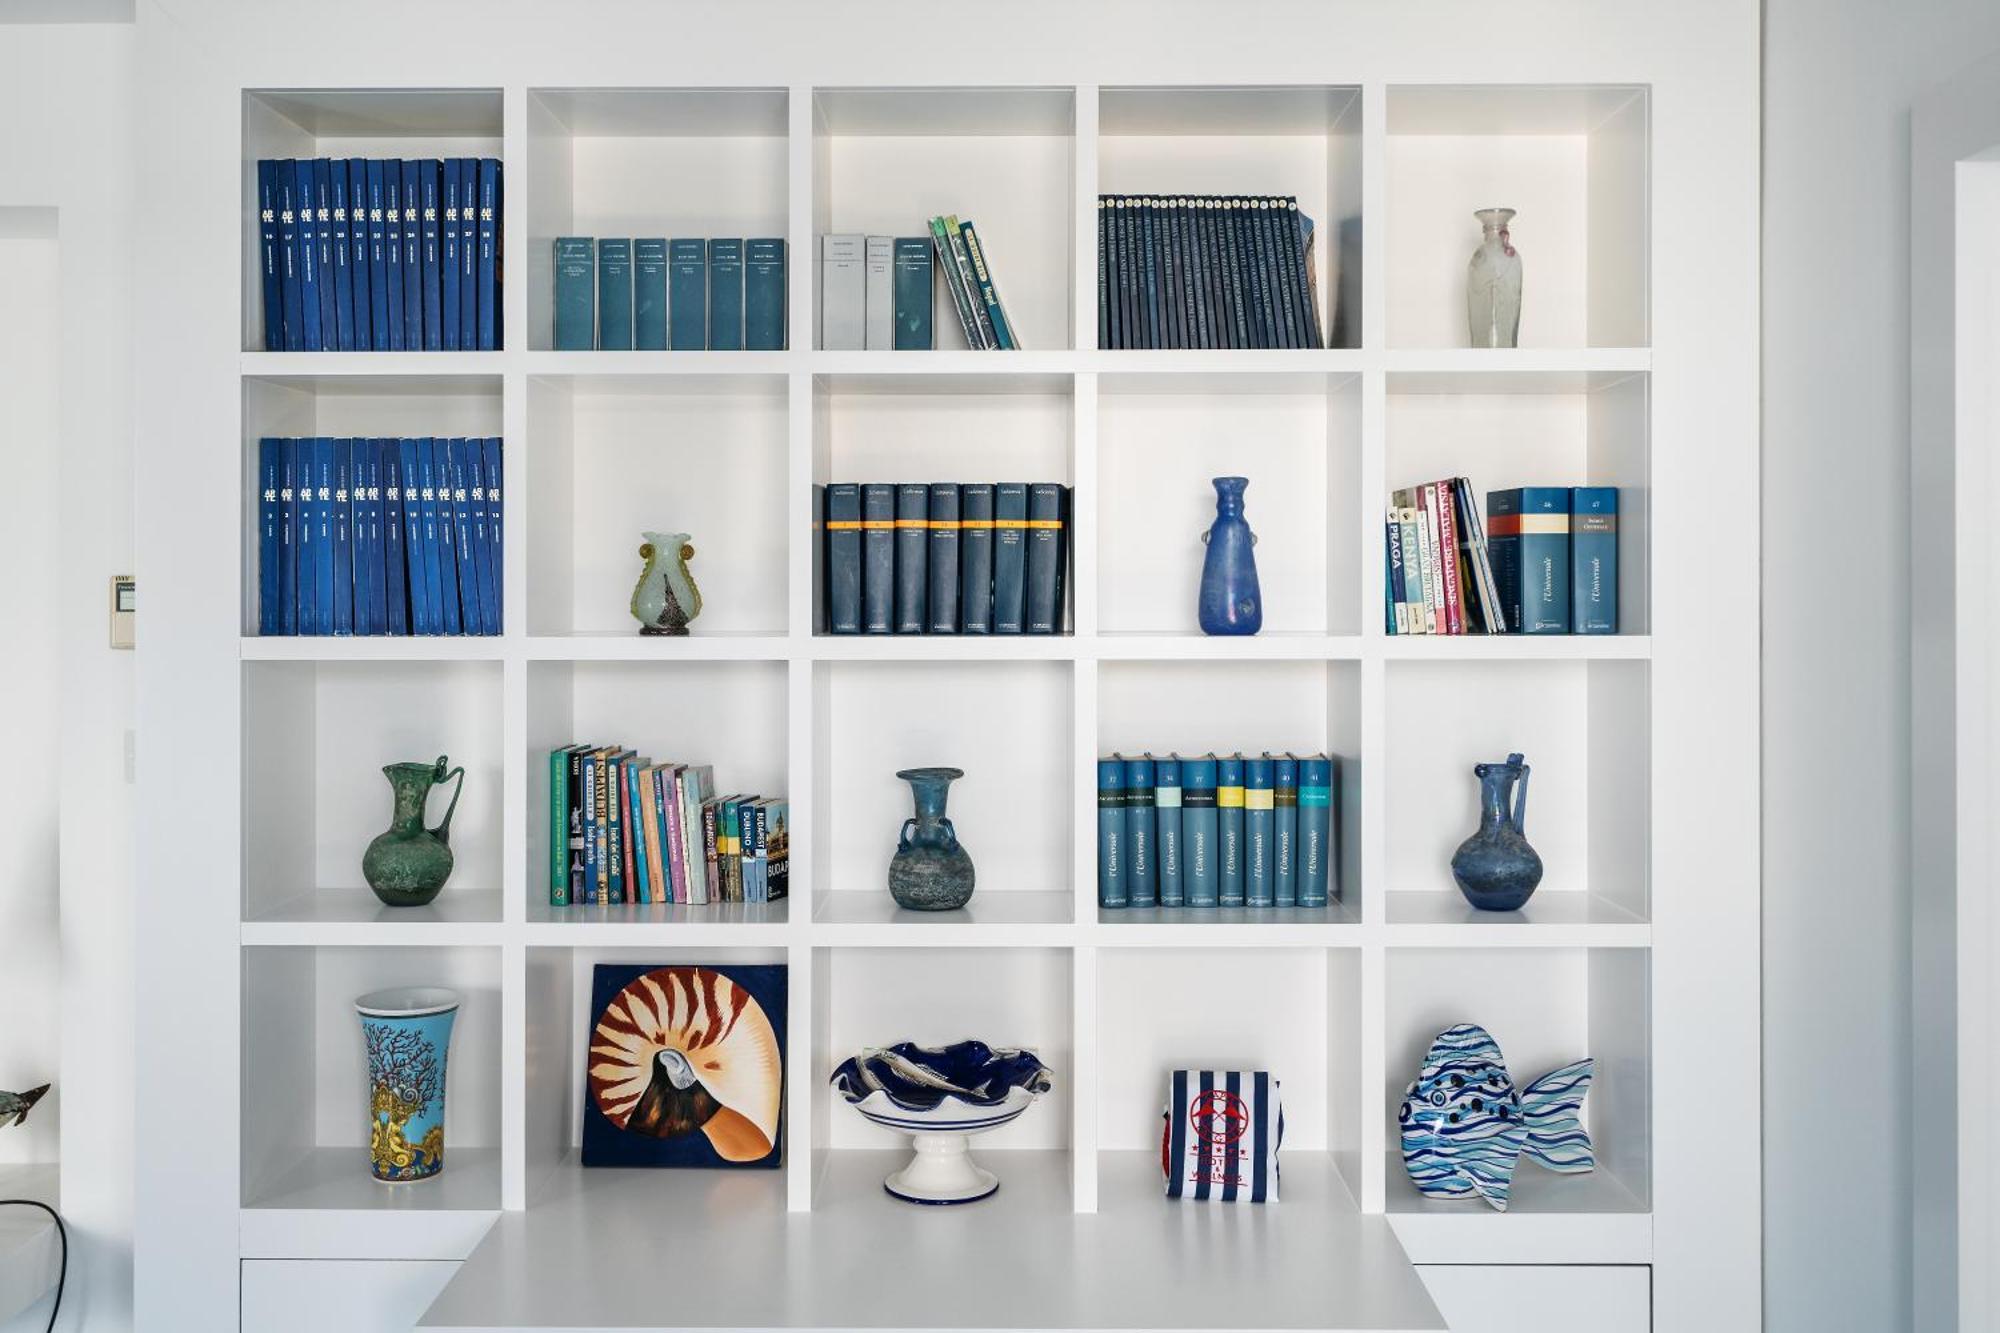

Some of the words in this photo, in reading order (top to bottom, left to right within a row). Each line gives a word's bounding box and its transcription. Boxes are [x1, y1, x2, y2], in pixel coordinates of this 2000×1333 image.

[1438, 482, 1450, 538] MALAYSIA
[1390, 525, 1401, 570] PRAGA
[1402, 524, 1416, 578] KENYA
[596, 752, 606, 818] BUDAPEST
[744, 812, 752, 846] DUBLINO
